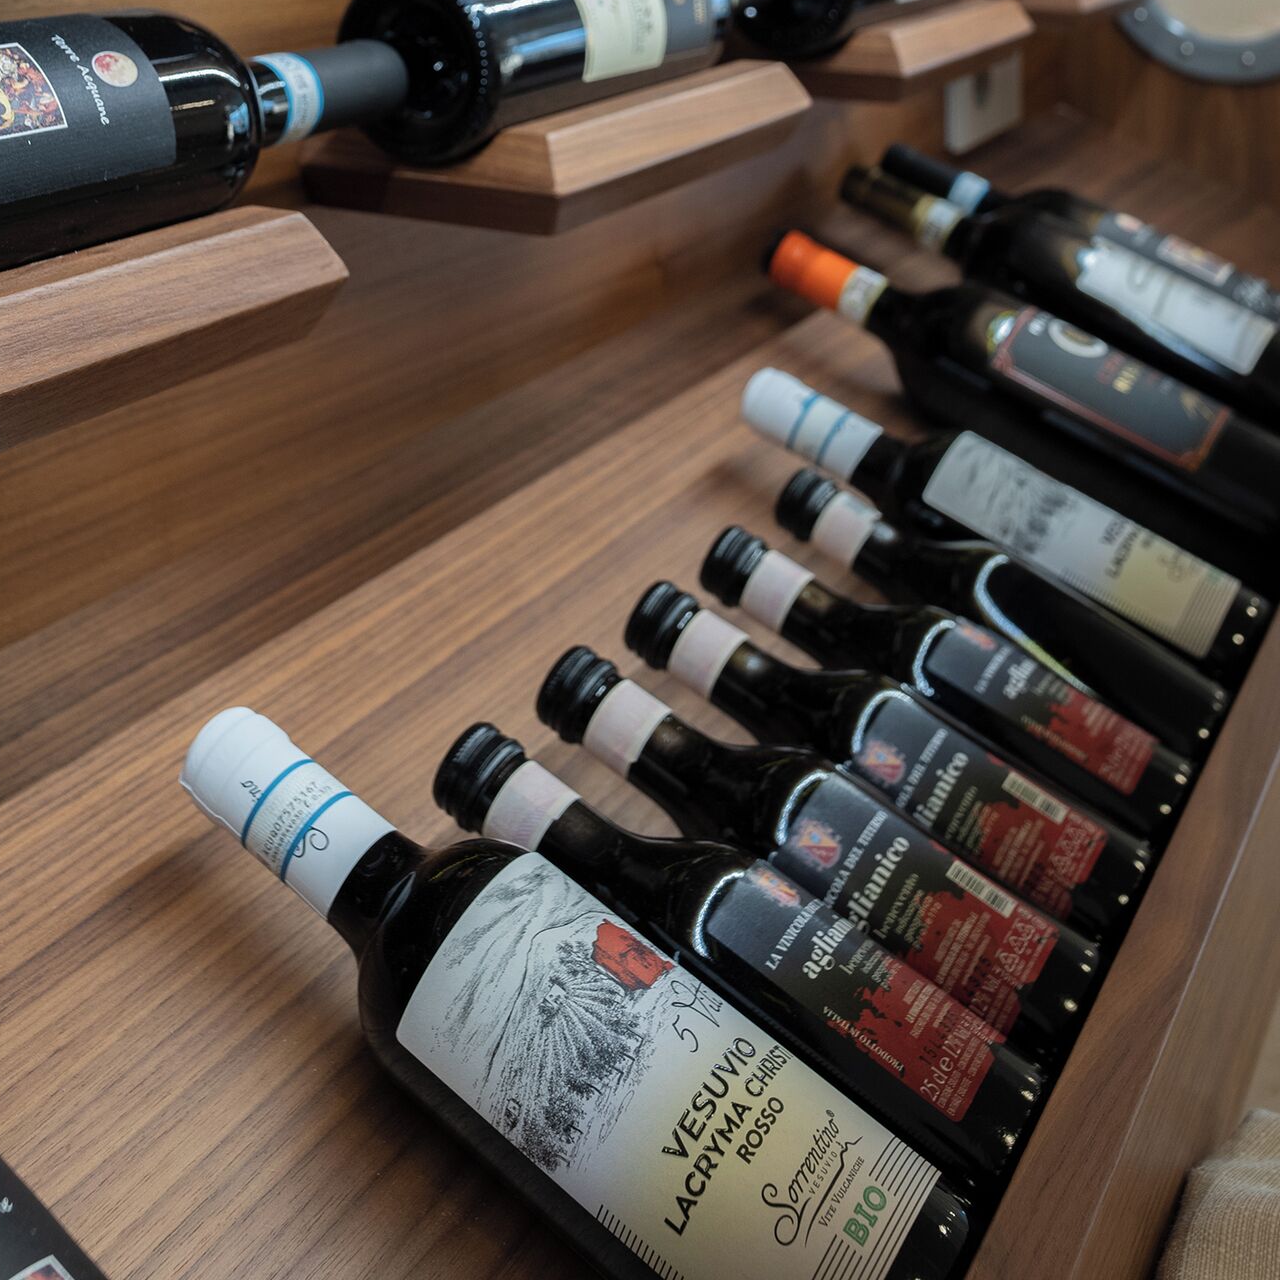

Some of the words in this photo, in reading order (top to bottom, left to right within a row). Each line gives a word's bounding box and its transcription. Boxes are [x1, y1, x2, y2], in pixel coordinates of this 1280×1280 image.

[51, 33, 80, 63] Terre
[77, 64, 110, 126] Aequane
[765, 953, 783, 971] LA
[775, 908, 813, 952] VINICOLA
[672, 1014, 699, 1053] 5
[661, 1036, 757, 1159] VESUVIO
[920, 1079, 941, 1102] 25
[736, 1096, 785, 1165] ROSSO
[663, 1101, 753, 1237] LACRYMA
[808, 1150, 837, 1195] VESUVIO
[842, 1185, 887, 1247] BIO
